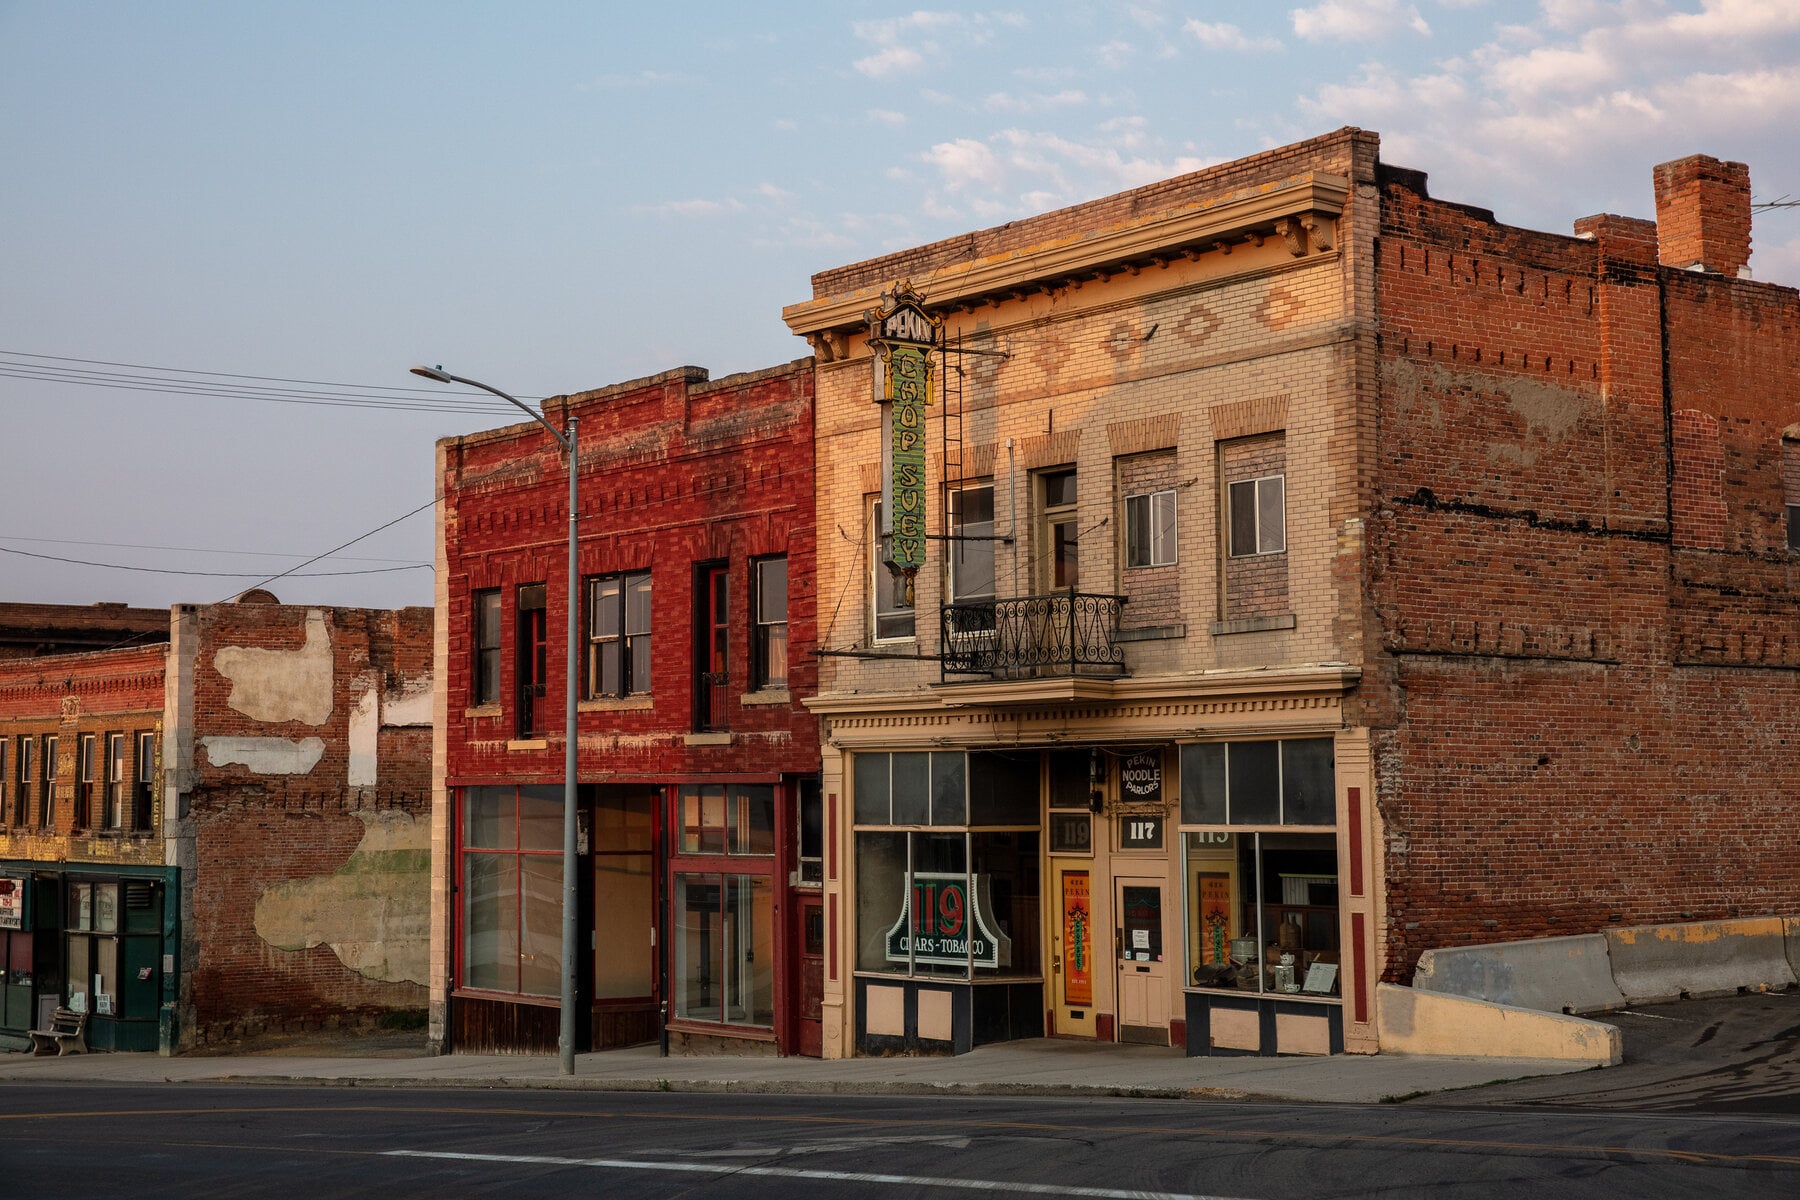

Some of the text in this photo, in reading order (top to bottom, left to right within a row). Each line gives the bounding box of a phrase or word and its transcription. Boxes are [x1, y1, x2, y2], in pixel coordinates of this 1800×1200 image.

[885, 308, 932, 342] PEKIN
[899, 353, 919, 563] CHOP SUEY
[1126, 755, 1156, 769] PEKIN
[1122, 769, 1160, 782] NOODLE
[1125, 781, 1159, 795] PARLORS
[1064, 822, 1090, 845] 119
[1130, 822, 1155, 840] 117
[899, 936, 935, 953] CIARS
